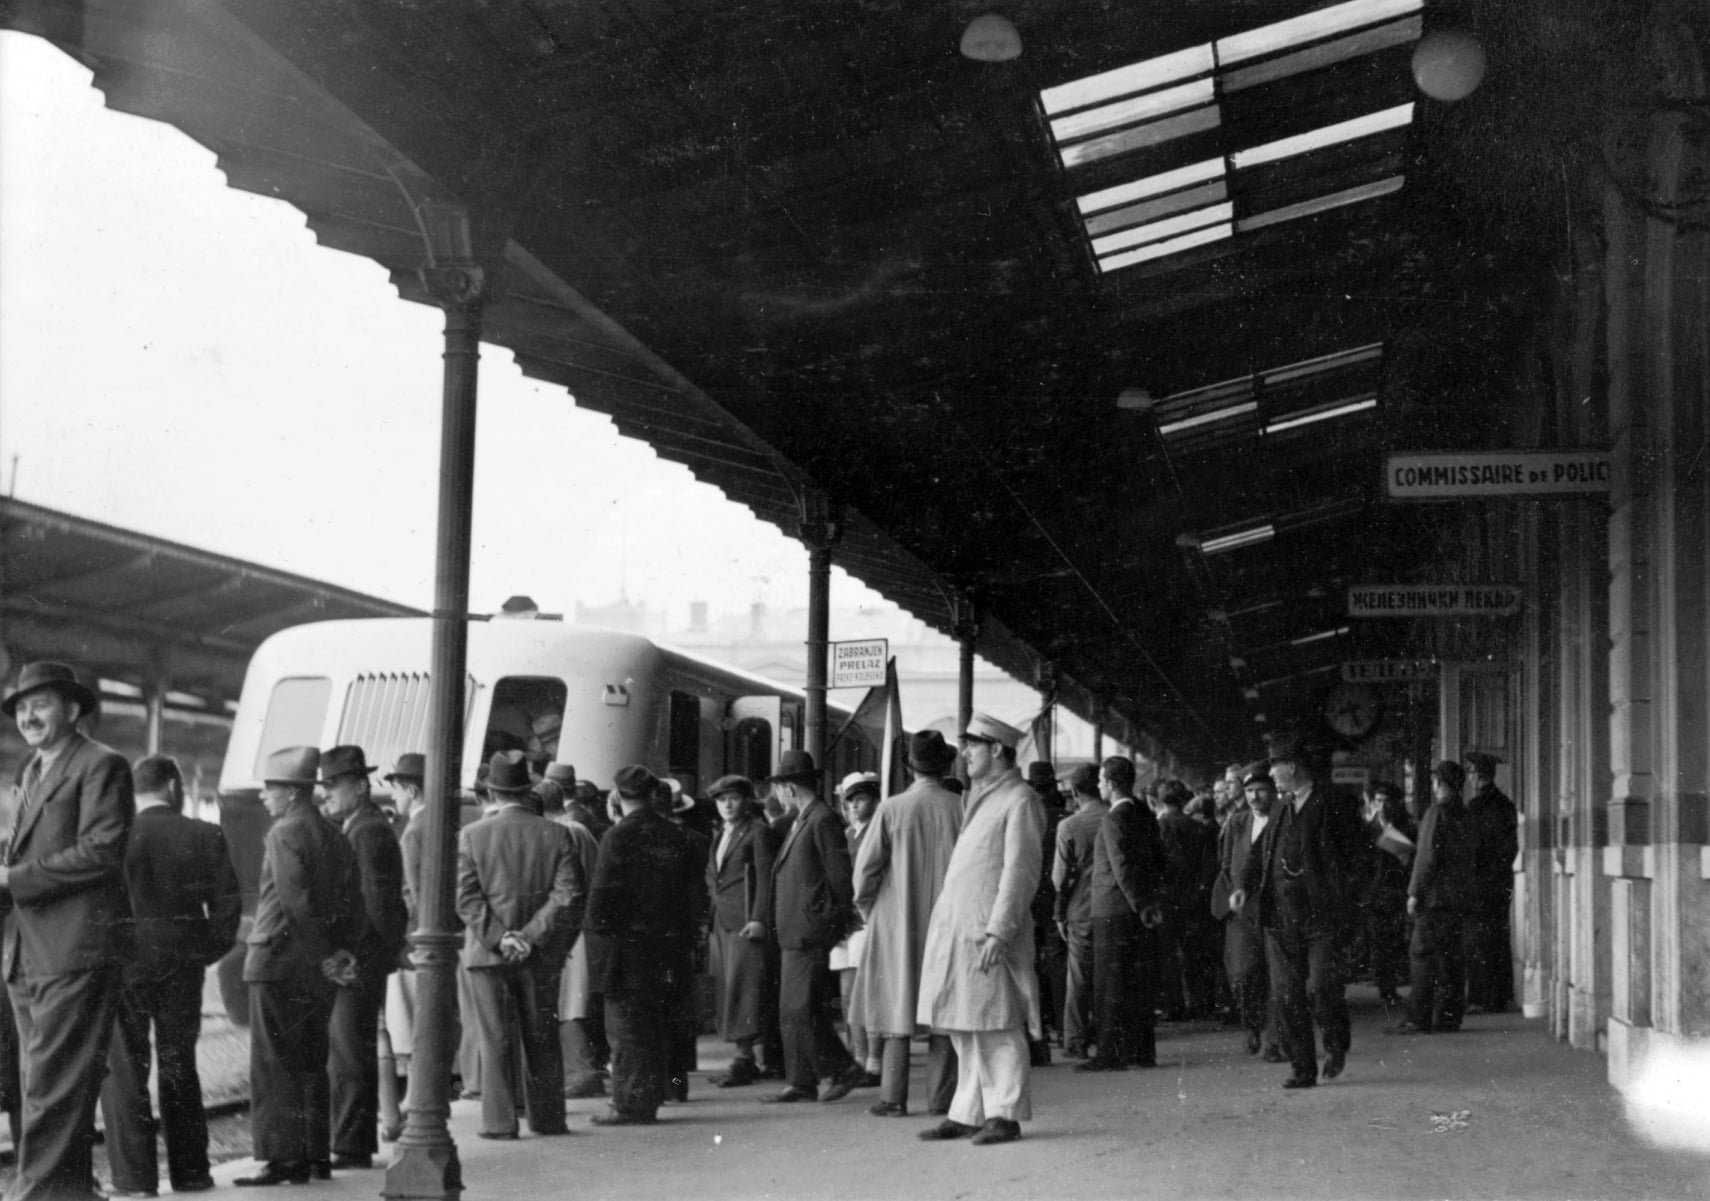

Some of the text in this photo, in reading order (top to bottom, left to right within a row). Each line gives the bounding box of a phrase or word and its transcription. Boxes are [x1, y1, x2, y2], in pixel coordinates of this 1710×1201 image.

[1395, 461, 1610, 486] COMMISSAIRE DE POLIC
[838, 645, 882, 659] ZABRANJEN
[840, 660, 880, 670] PRELAZ
